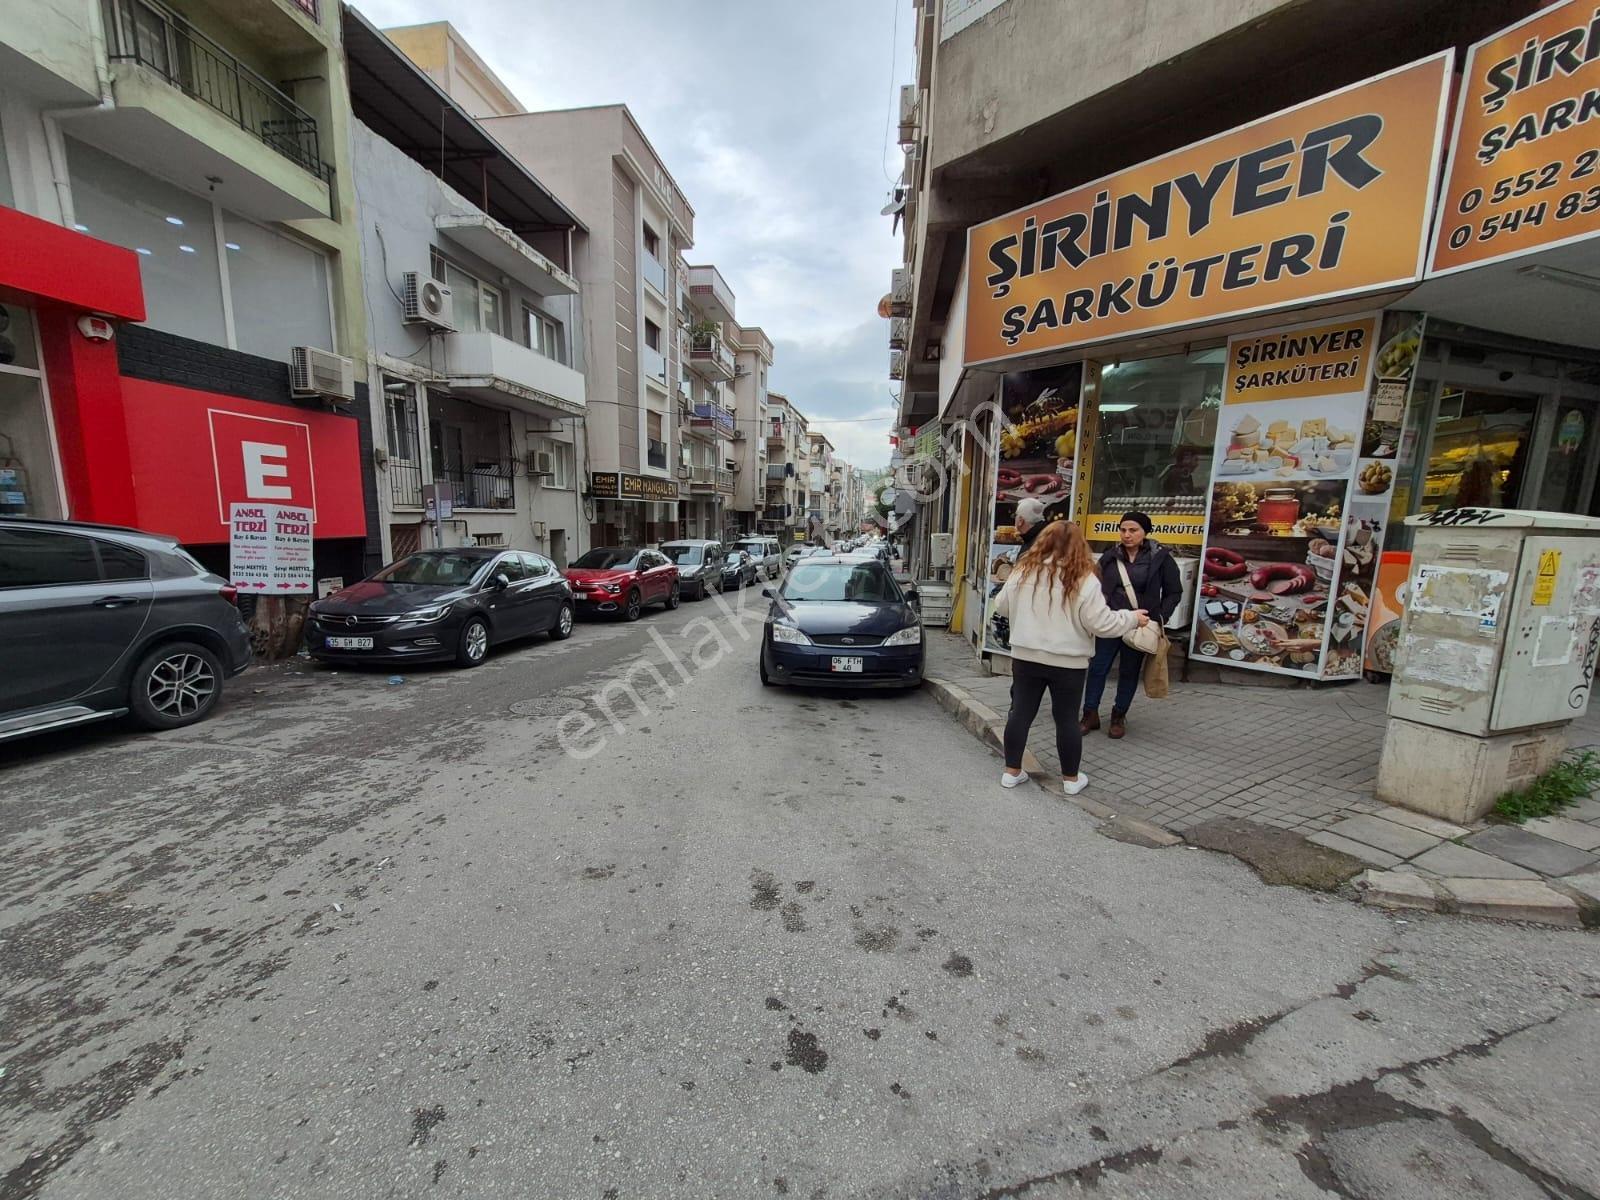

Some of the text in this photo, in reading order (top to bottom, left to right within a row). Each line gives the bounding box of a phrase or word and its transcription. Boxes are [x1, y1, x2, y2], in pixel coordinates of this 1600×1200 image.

[986, 112, 1385, 299] ŞİRİNYER
[1459, 188, 1483, 214] 0
[1490, 161, 1563, 205] 552
[1449, 224, 1472, 250] 0
[1477, 201, 1547, 242] 544
[1001, 210, 1352, 346] ŞARKÜTERİ
[1236, 328, 1364, 370] ŞİRİNYER
[1234, 356, 1359, 393] ŞARKÜTERİ
[241, 440, 293, 500] E
[234, 519, 268, 532] TERZİ
[275, 523, 310, 536] TERZİ
[330, 638, 339, 647] 35
[358, 638, 372, 647] 827
